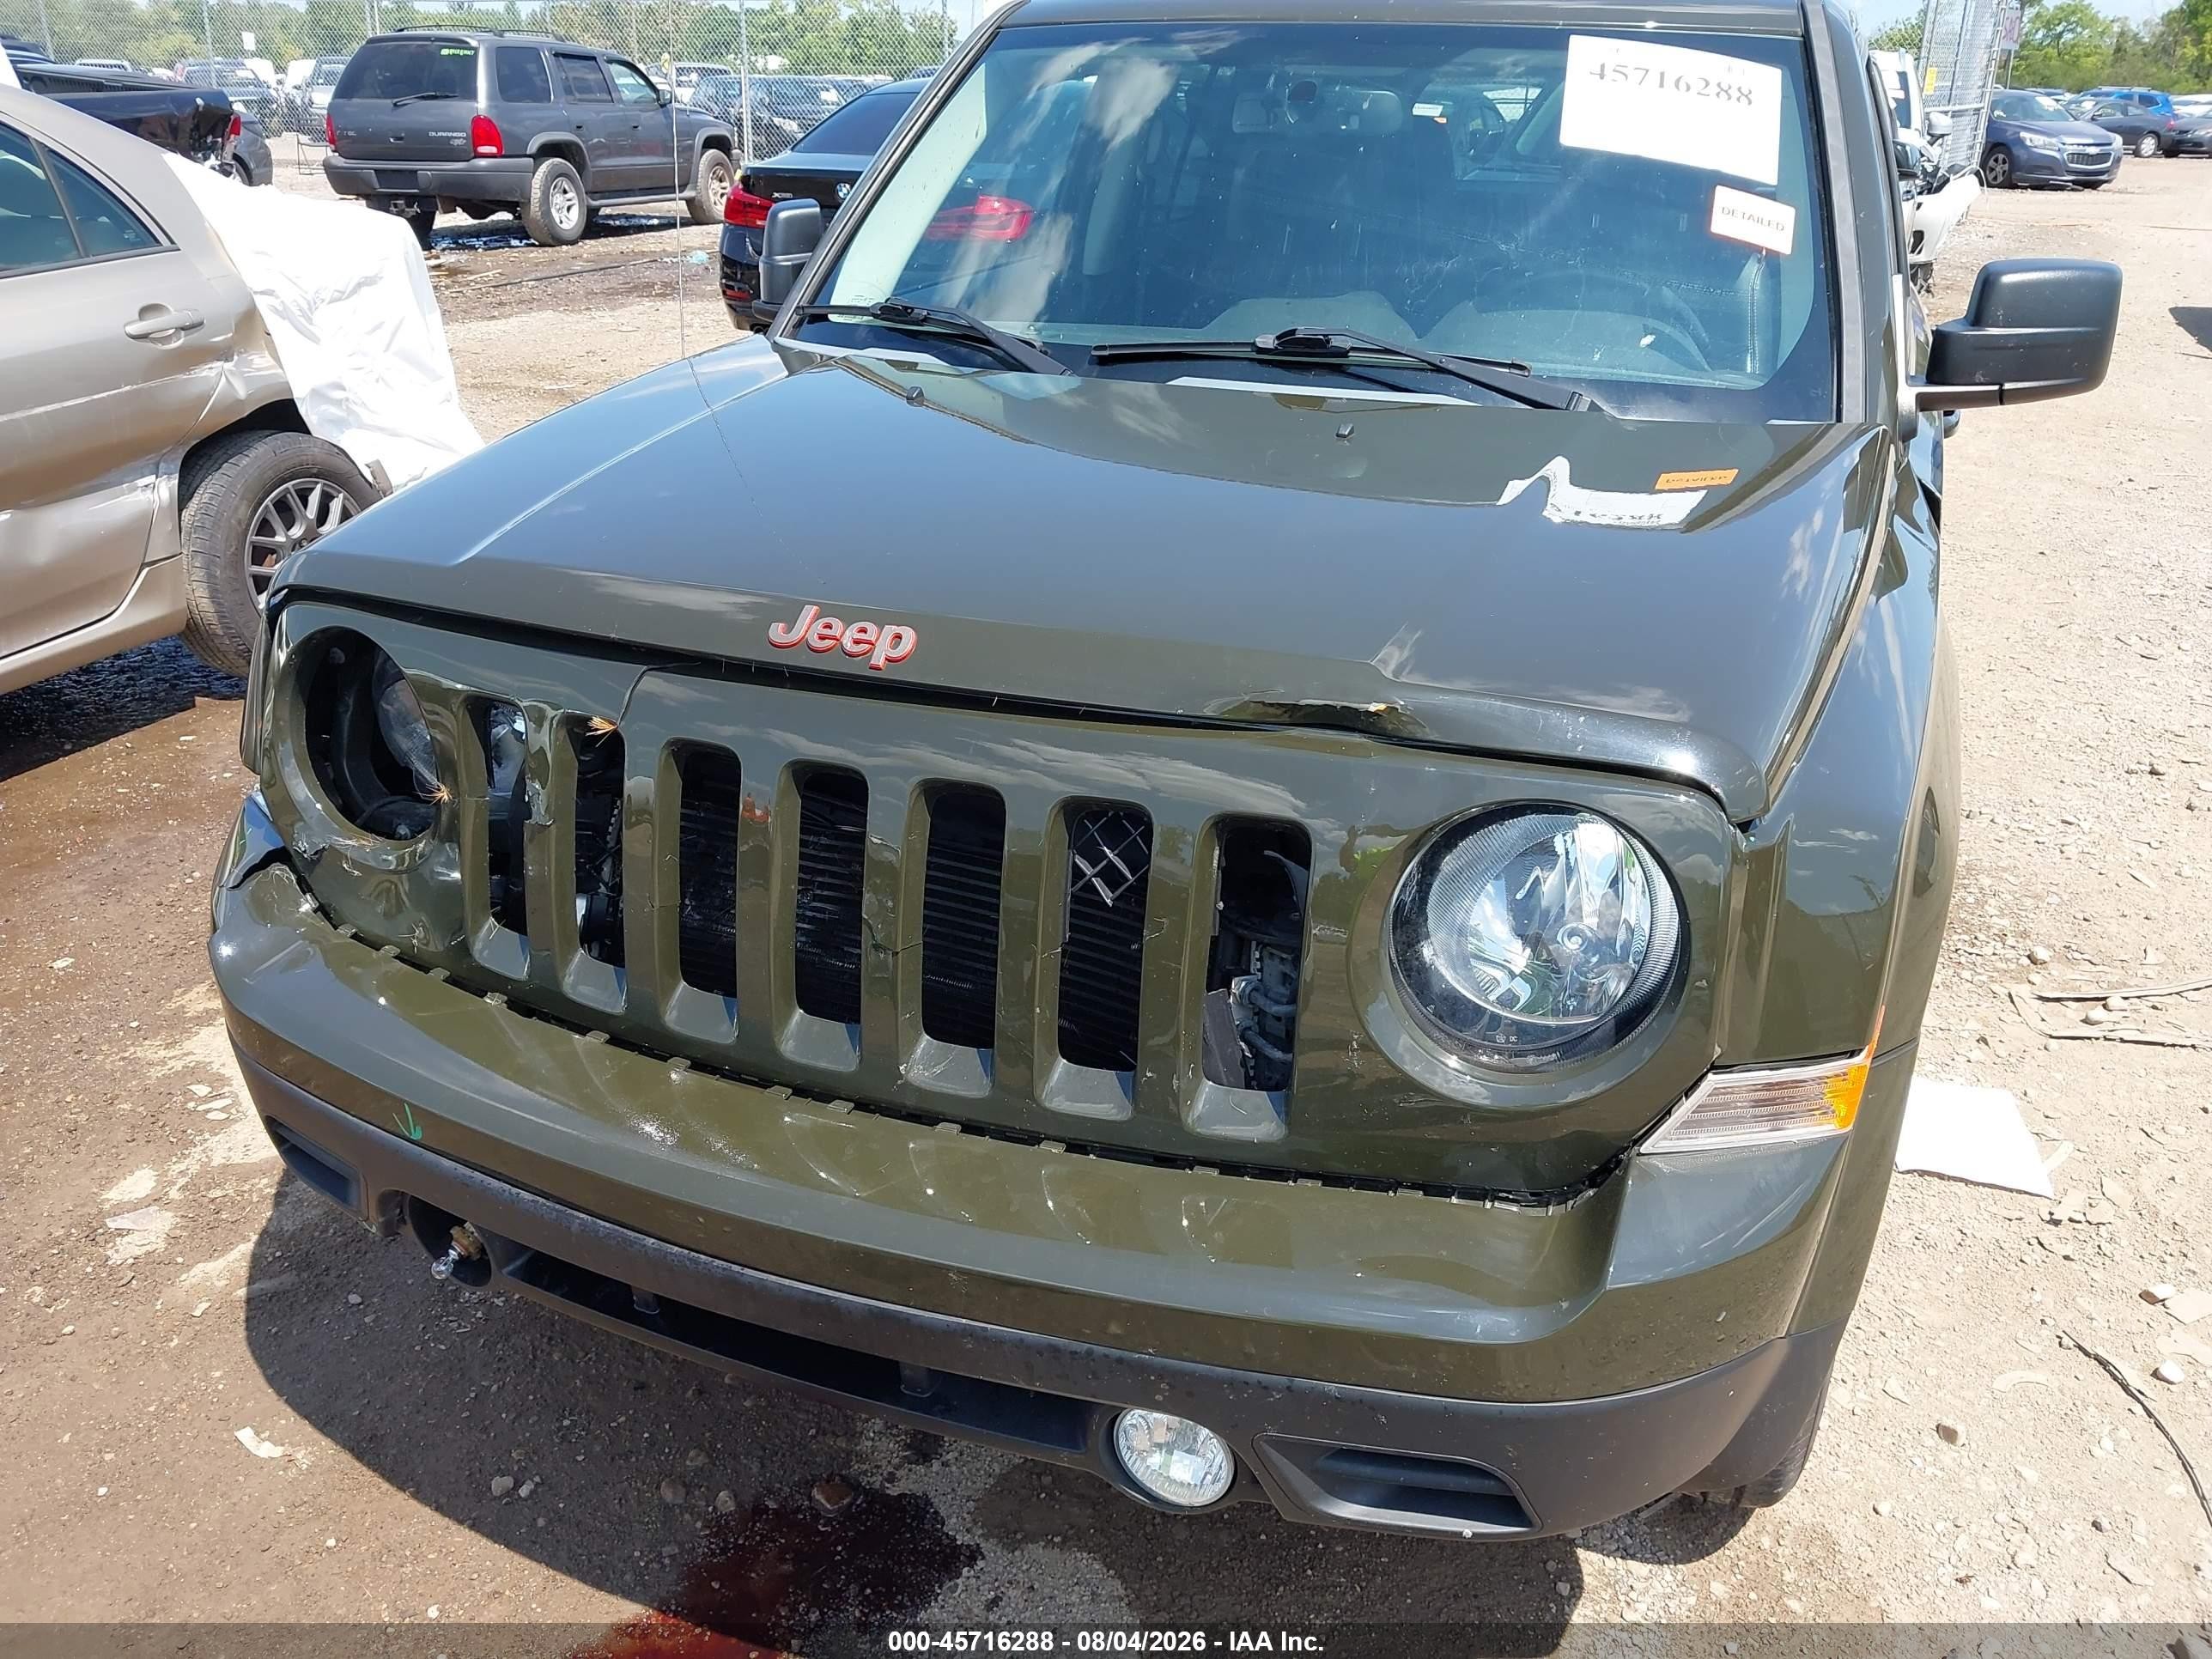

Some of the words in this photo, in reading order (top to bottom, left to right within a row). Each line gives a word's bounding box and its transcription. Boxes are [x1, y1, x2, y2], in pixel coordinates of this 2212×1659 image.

[1589, 62, 1753, 106] 45716288
[1721, 206, 1785, 232] DETAILED
[768, 604, 918, 672] Jeep
